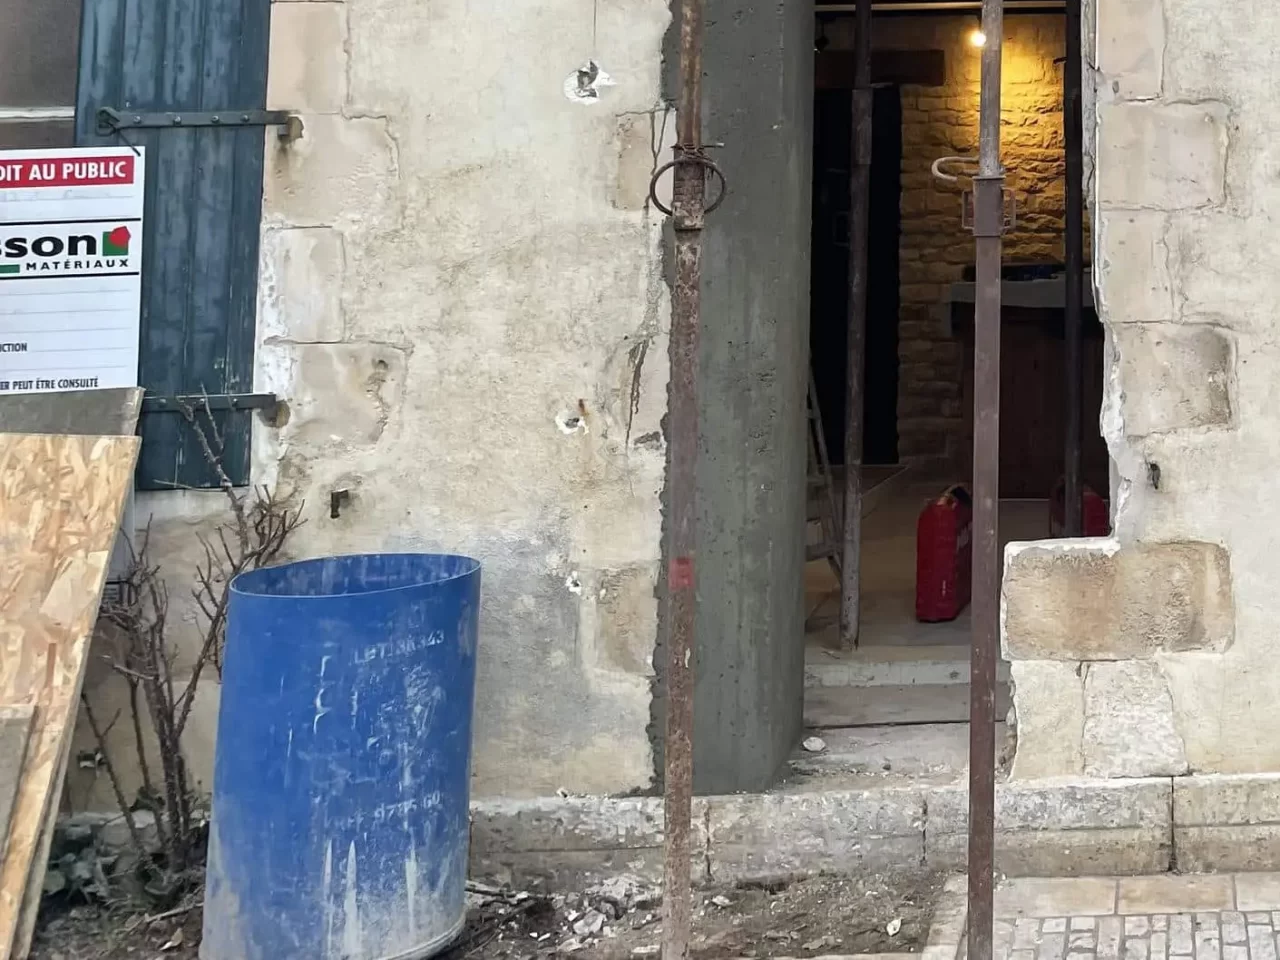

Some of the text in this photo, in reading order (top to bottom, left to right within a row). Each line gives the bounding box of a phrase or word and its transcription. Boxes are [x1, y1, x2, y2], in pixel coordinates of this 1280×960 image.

[28, 163, 56, 181] AU
[62, 161, 127, 180] PUBLIC
[0, 235, 97, 258] son
[26, 259, 129, 271] MATÉRIAUX
[0, 342, 28, 353] CTION
[12, 380, 34, 391] PEUT
[57, 376, 99, 389] CONSULTÉ
